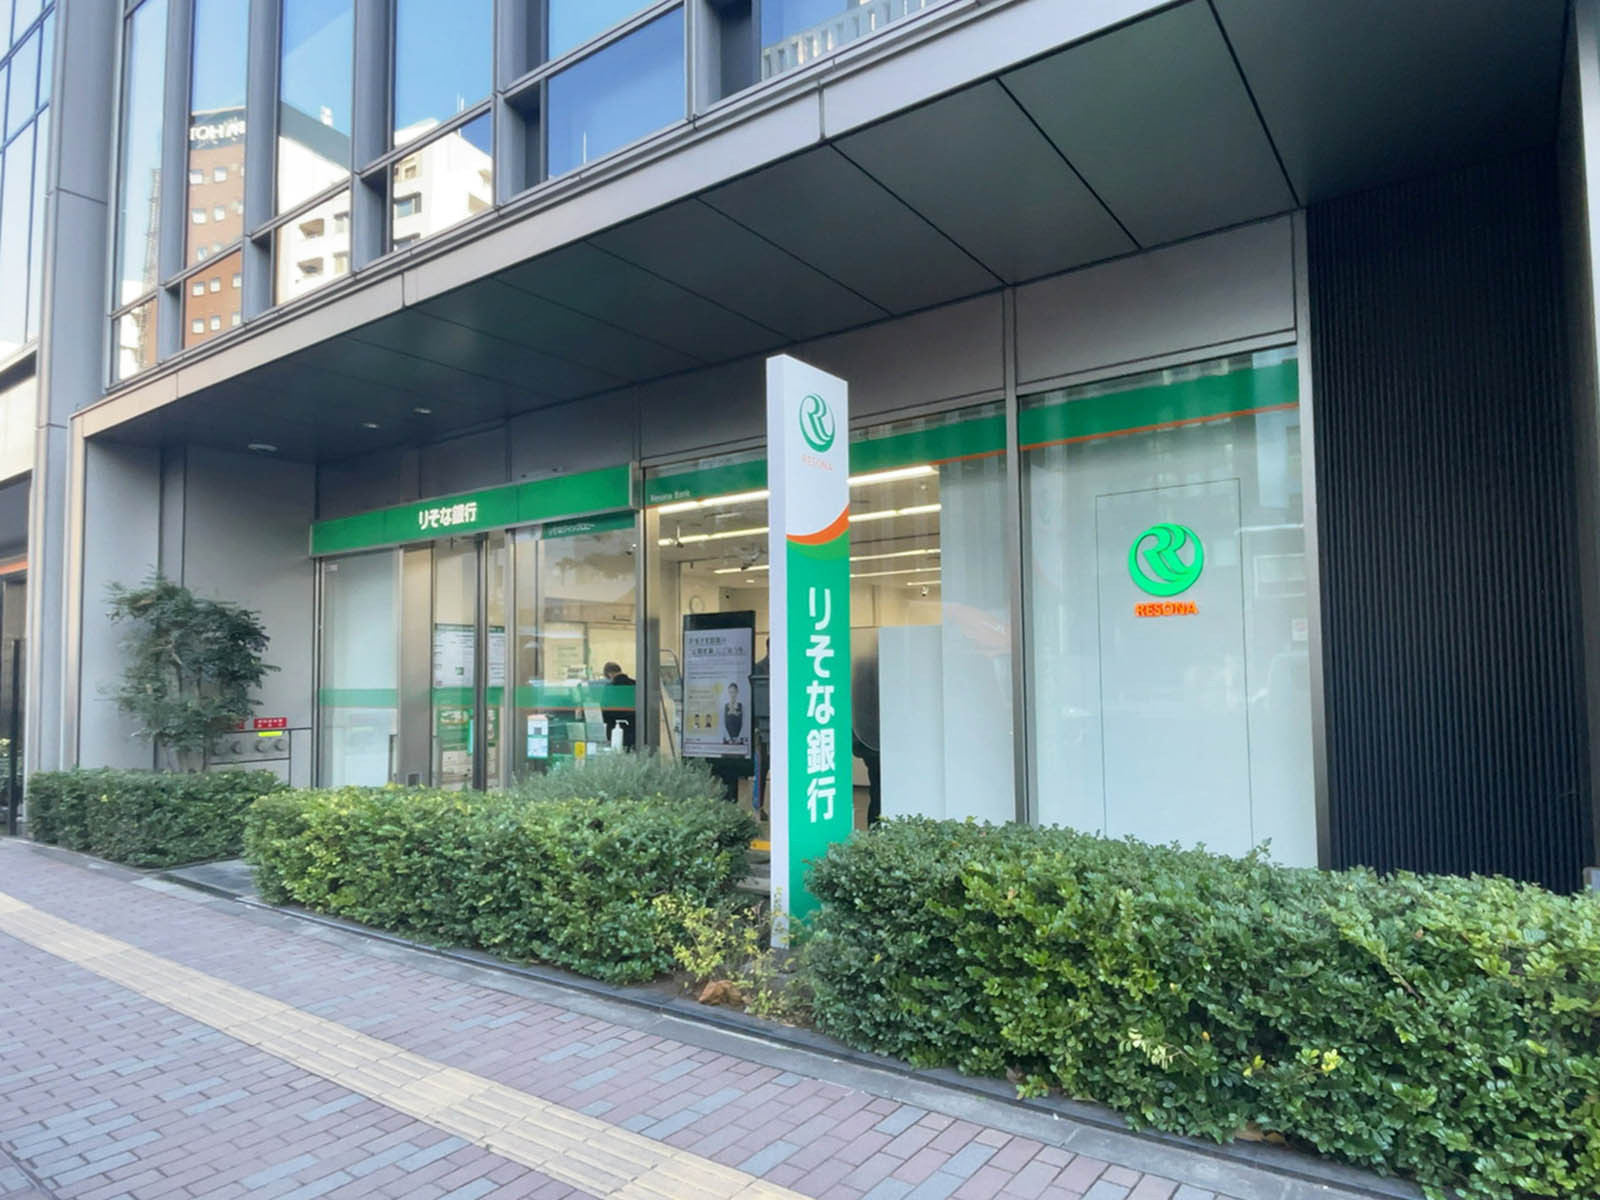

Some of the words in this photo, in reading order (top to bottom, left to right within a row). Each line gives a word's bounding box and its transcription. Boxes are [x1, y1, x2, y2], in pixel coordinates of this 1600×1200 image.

[418, 501, 477, 530] りそな銀行
[1134, 600, 1199, 617] RESONA
[805, 586, 836, 823] りそな銀行
